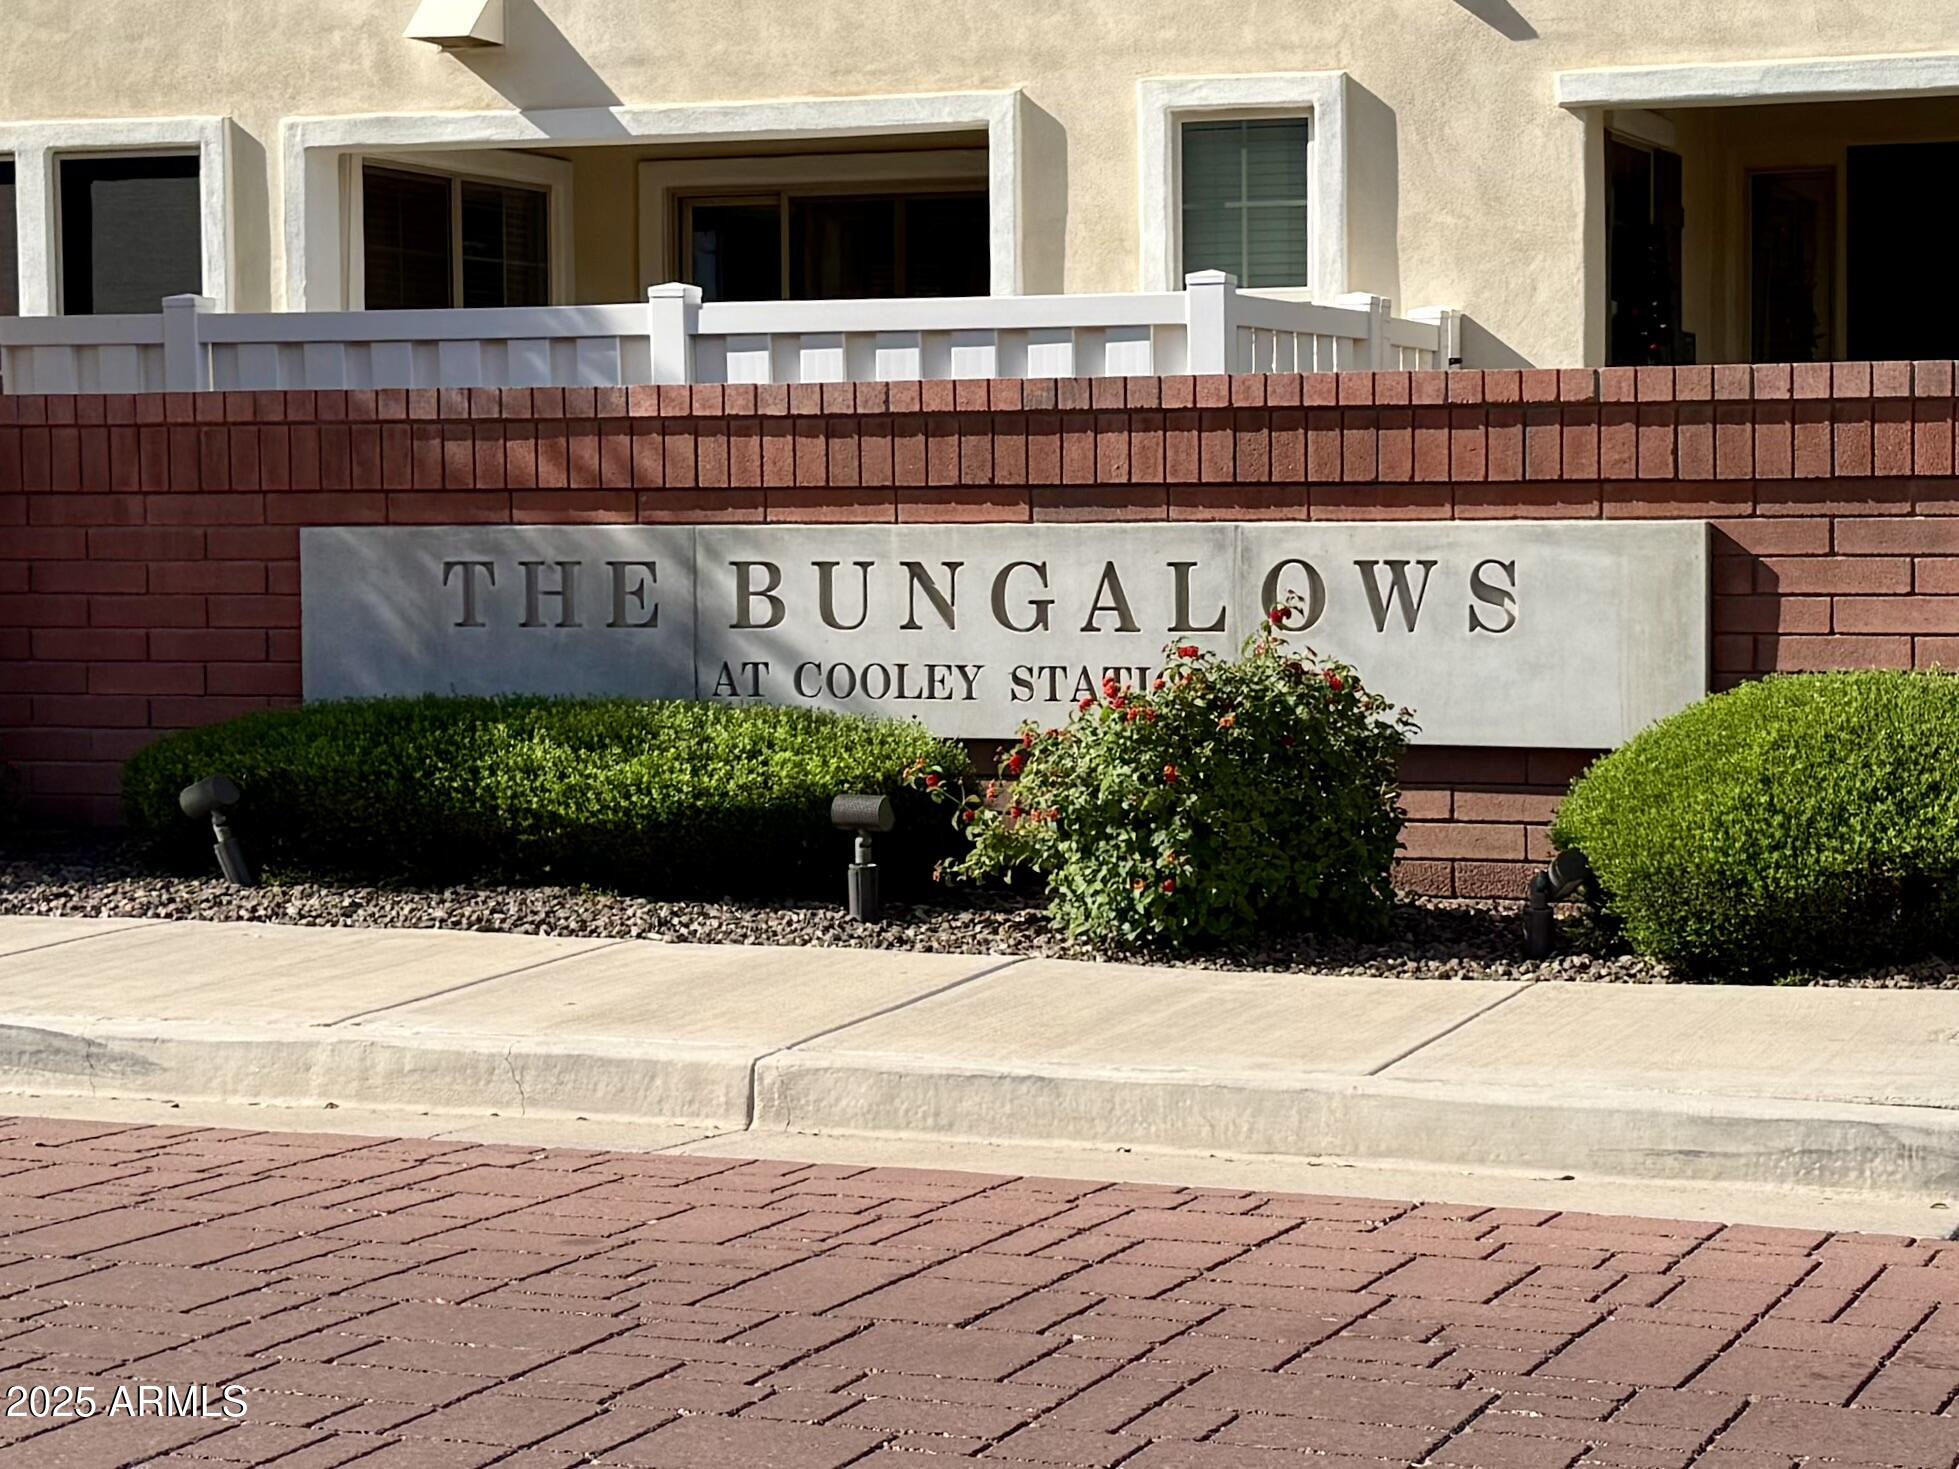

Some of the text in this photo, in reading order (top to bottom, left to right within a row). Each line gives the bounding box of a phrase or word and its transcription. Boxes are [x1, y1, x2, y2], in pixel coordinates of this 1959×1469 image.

[443, 558, 1518, 634] THE BUNGALOWS
[713, 662, 770, 697] AT
[794, 662, 984, 700] COOLEY
